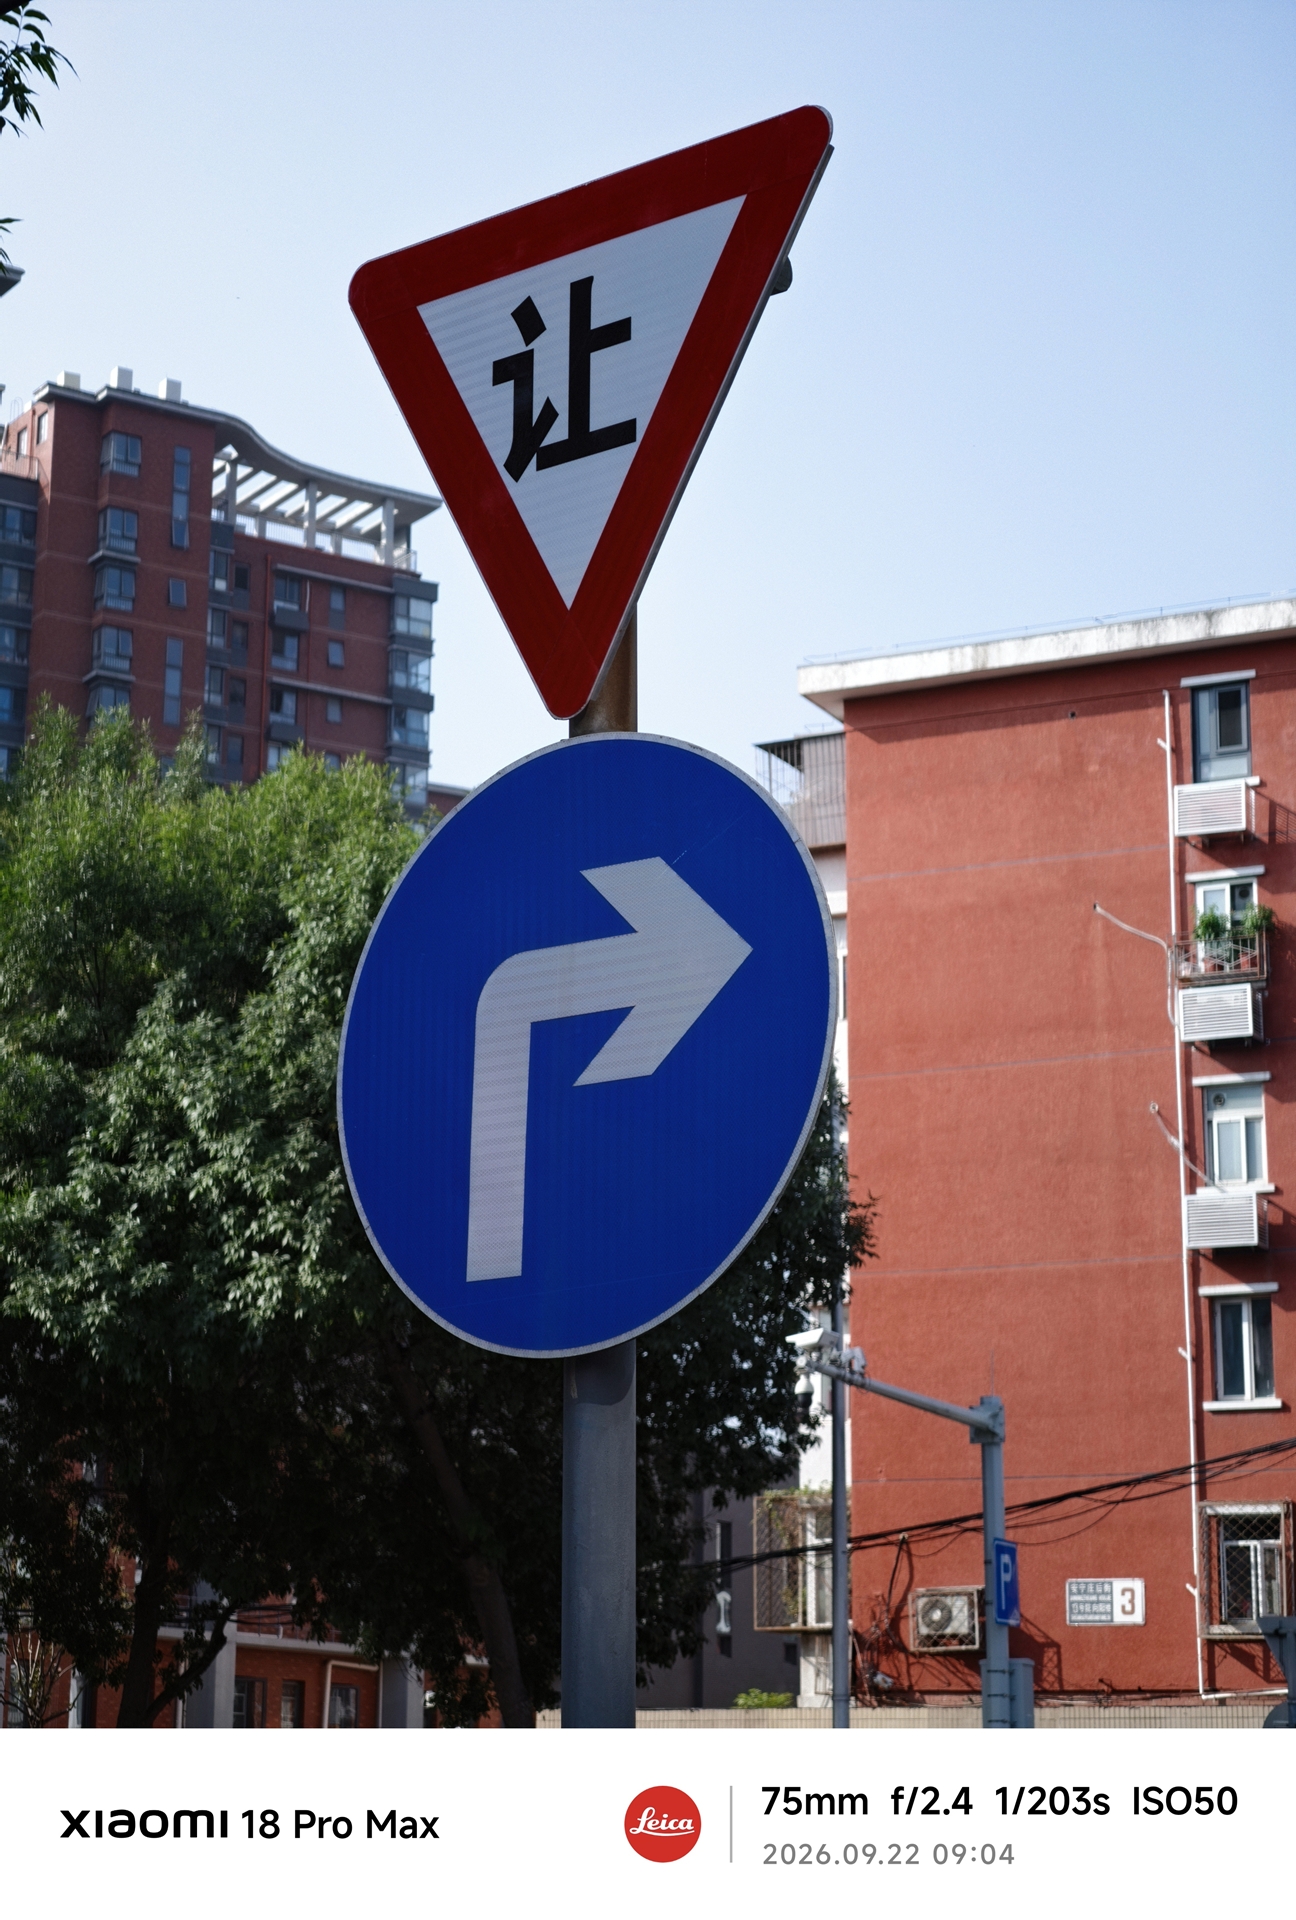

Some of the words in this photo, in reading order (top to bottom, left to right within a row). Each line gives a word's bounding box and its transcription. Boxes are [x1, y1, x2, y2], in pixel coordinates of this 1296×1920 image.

[492, 275, 637, 483] 让
[1000, 1553, 1012, 1610] P
[1121, 1587, 1135, 1615] 3
